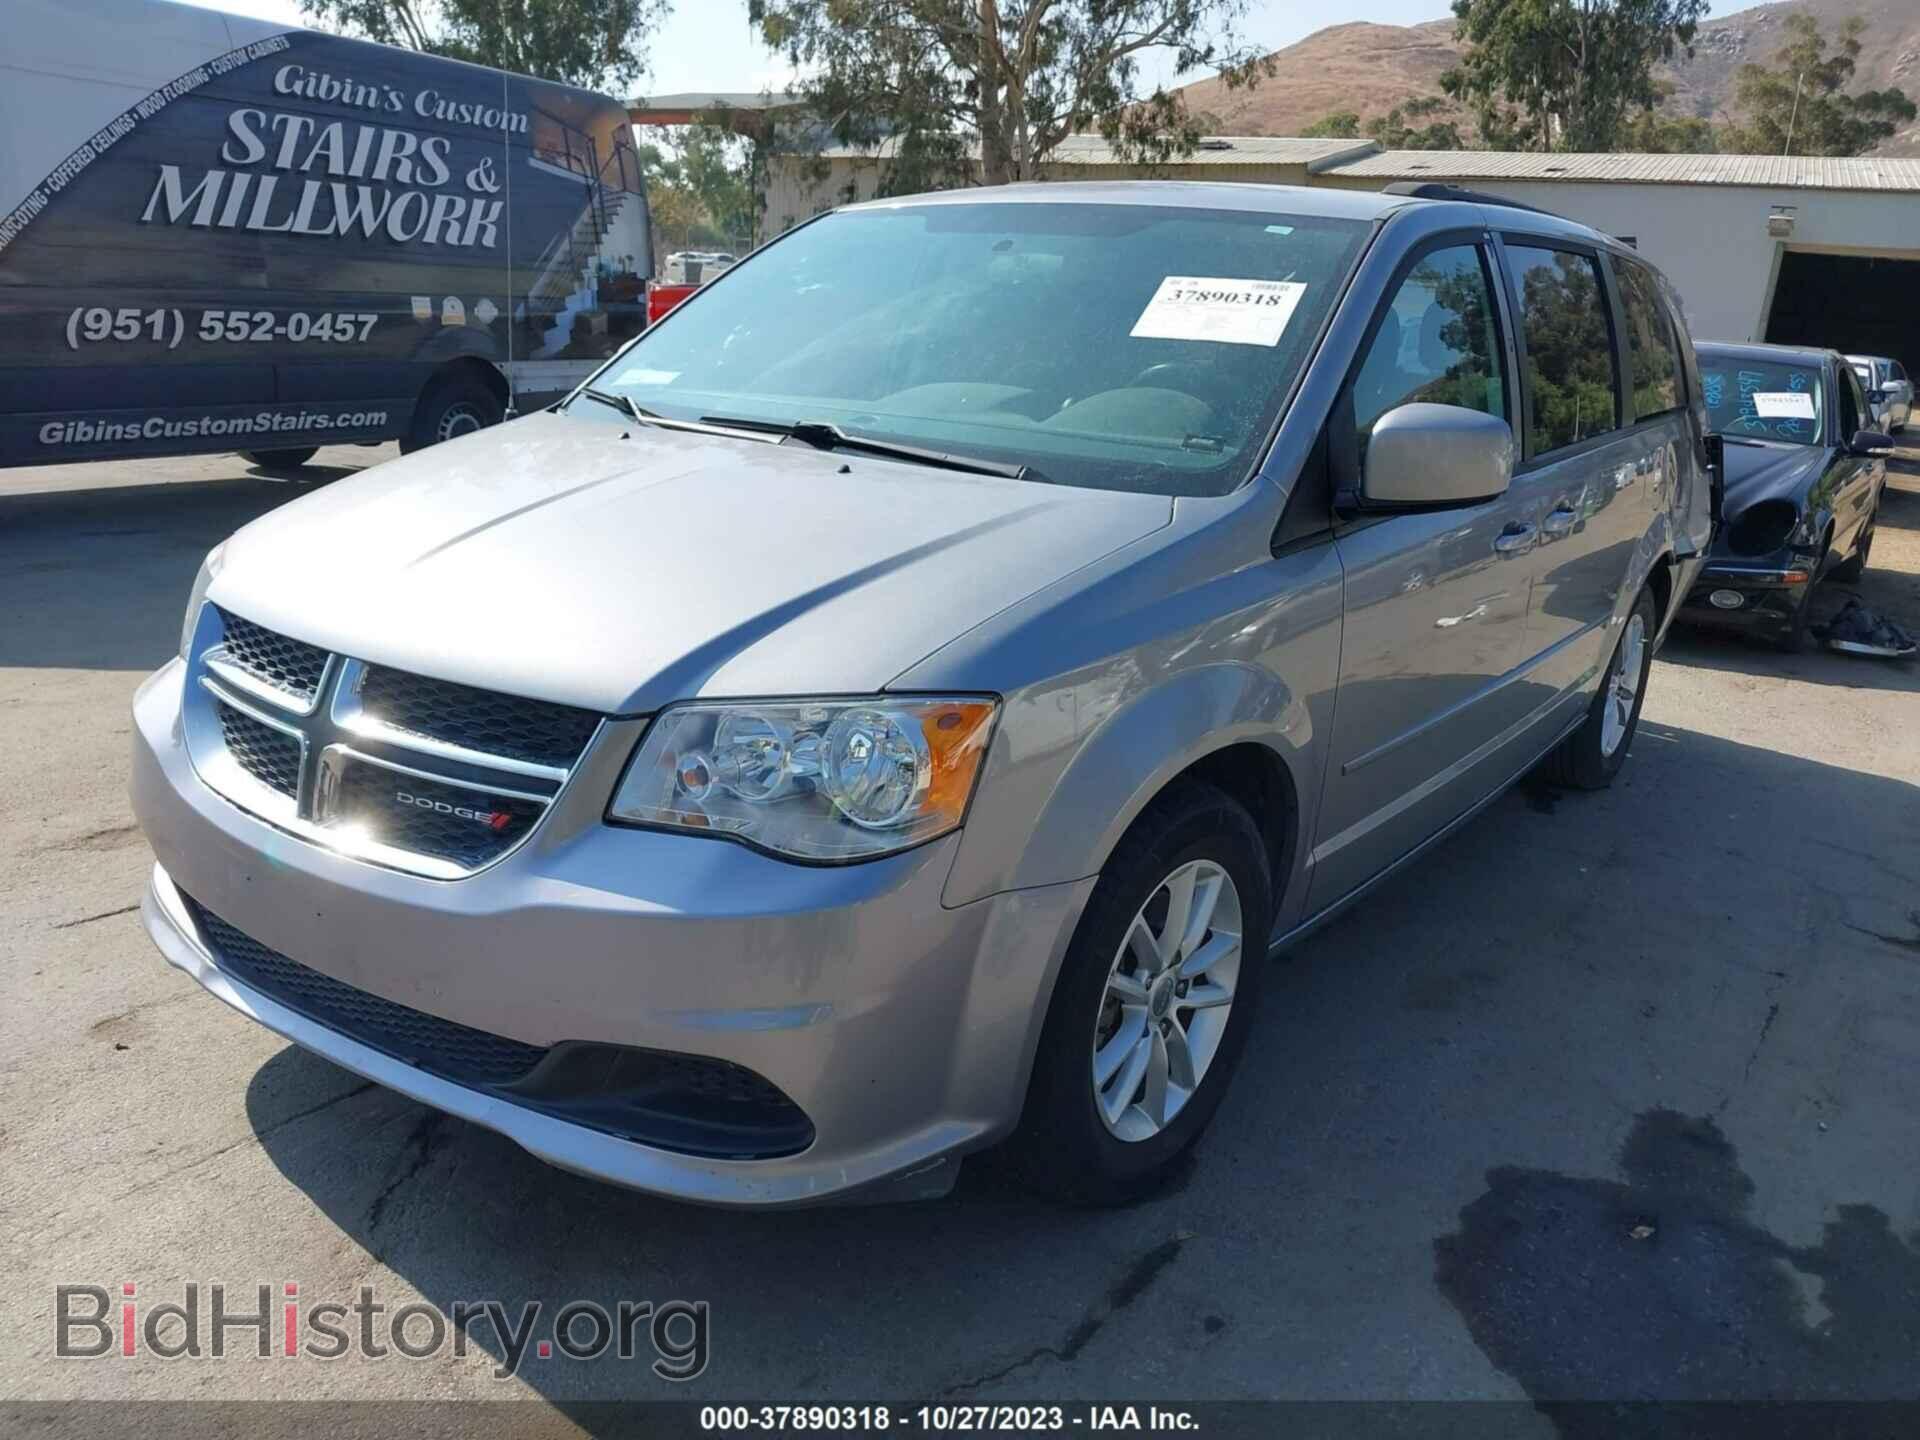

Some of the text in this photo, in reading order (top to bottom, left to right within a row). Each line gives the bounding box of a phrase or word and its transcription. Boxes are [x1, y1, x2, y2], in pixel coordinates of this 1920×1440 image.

[274, 64, 528, 133] Gibin's Custom
[0, 35, 290, 252] INSCOTING COFFERED CEILINGS WOOD FLOORING CUSTOM CABINETS
[222, 108, 501, 193] STAIRS &
[141, 164, 504, 248] MILLWORK
[1167, 289, 1282, 306] 37890318
[66, 307, 378, 349] (951) 552-0457
[39, 410, 388, 444] GibinsCustomStairs.com
[396, 791, 492, 824] DODGE
